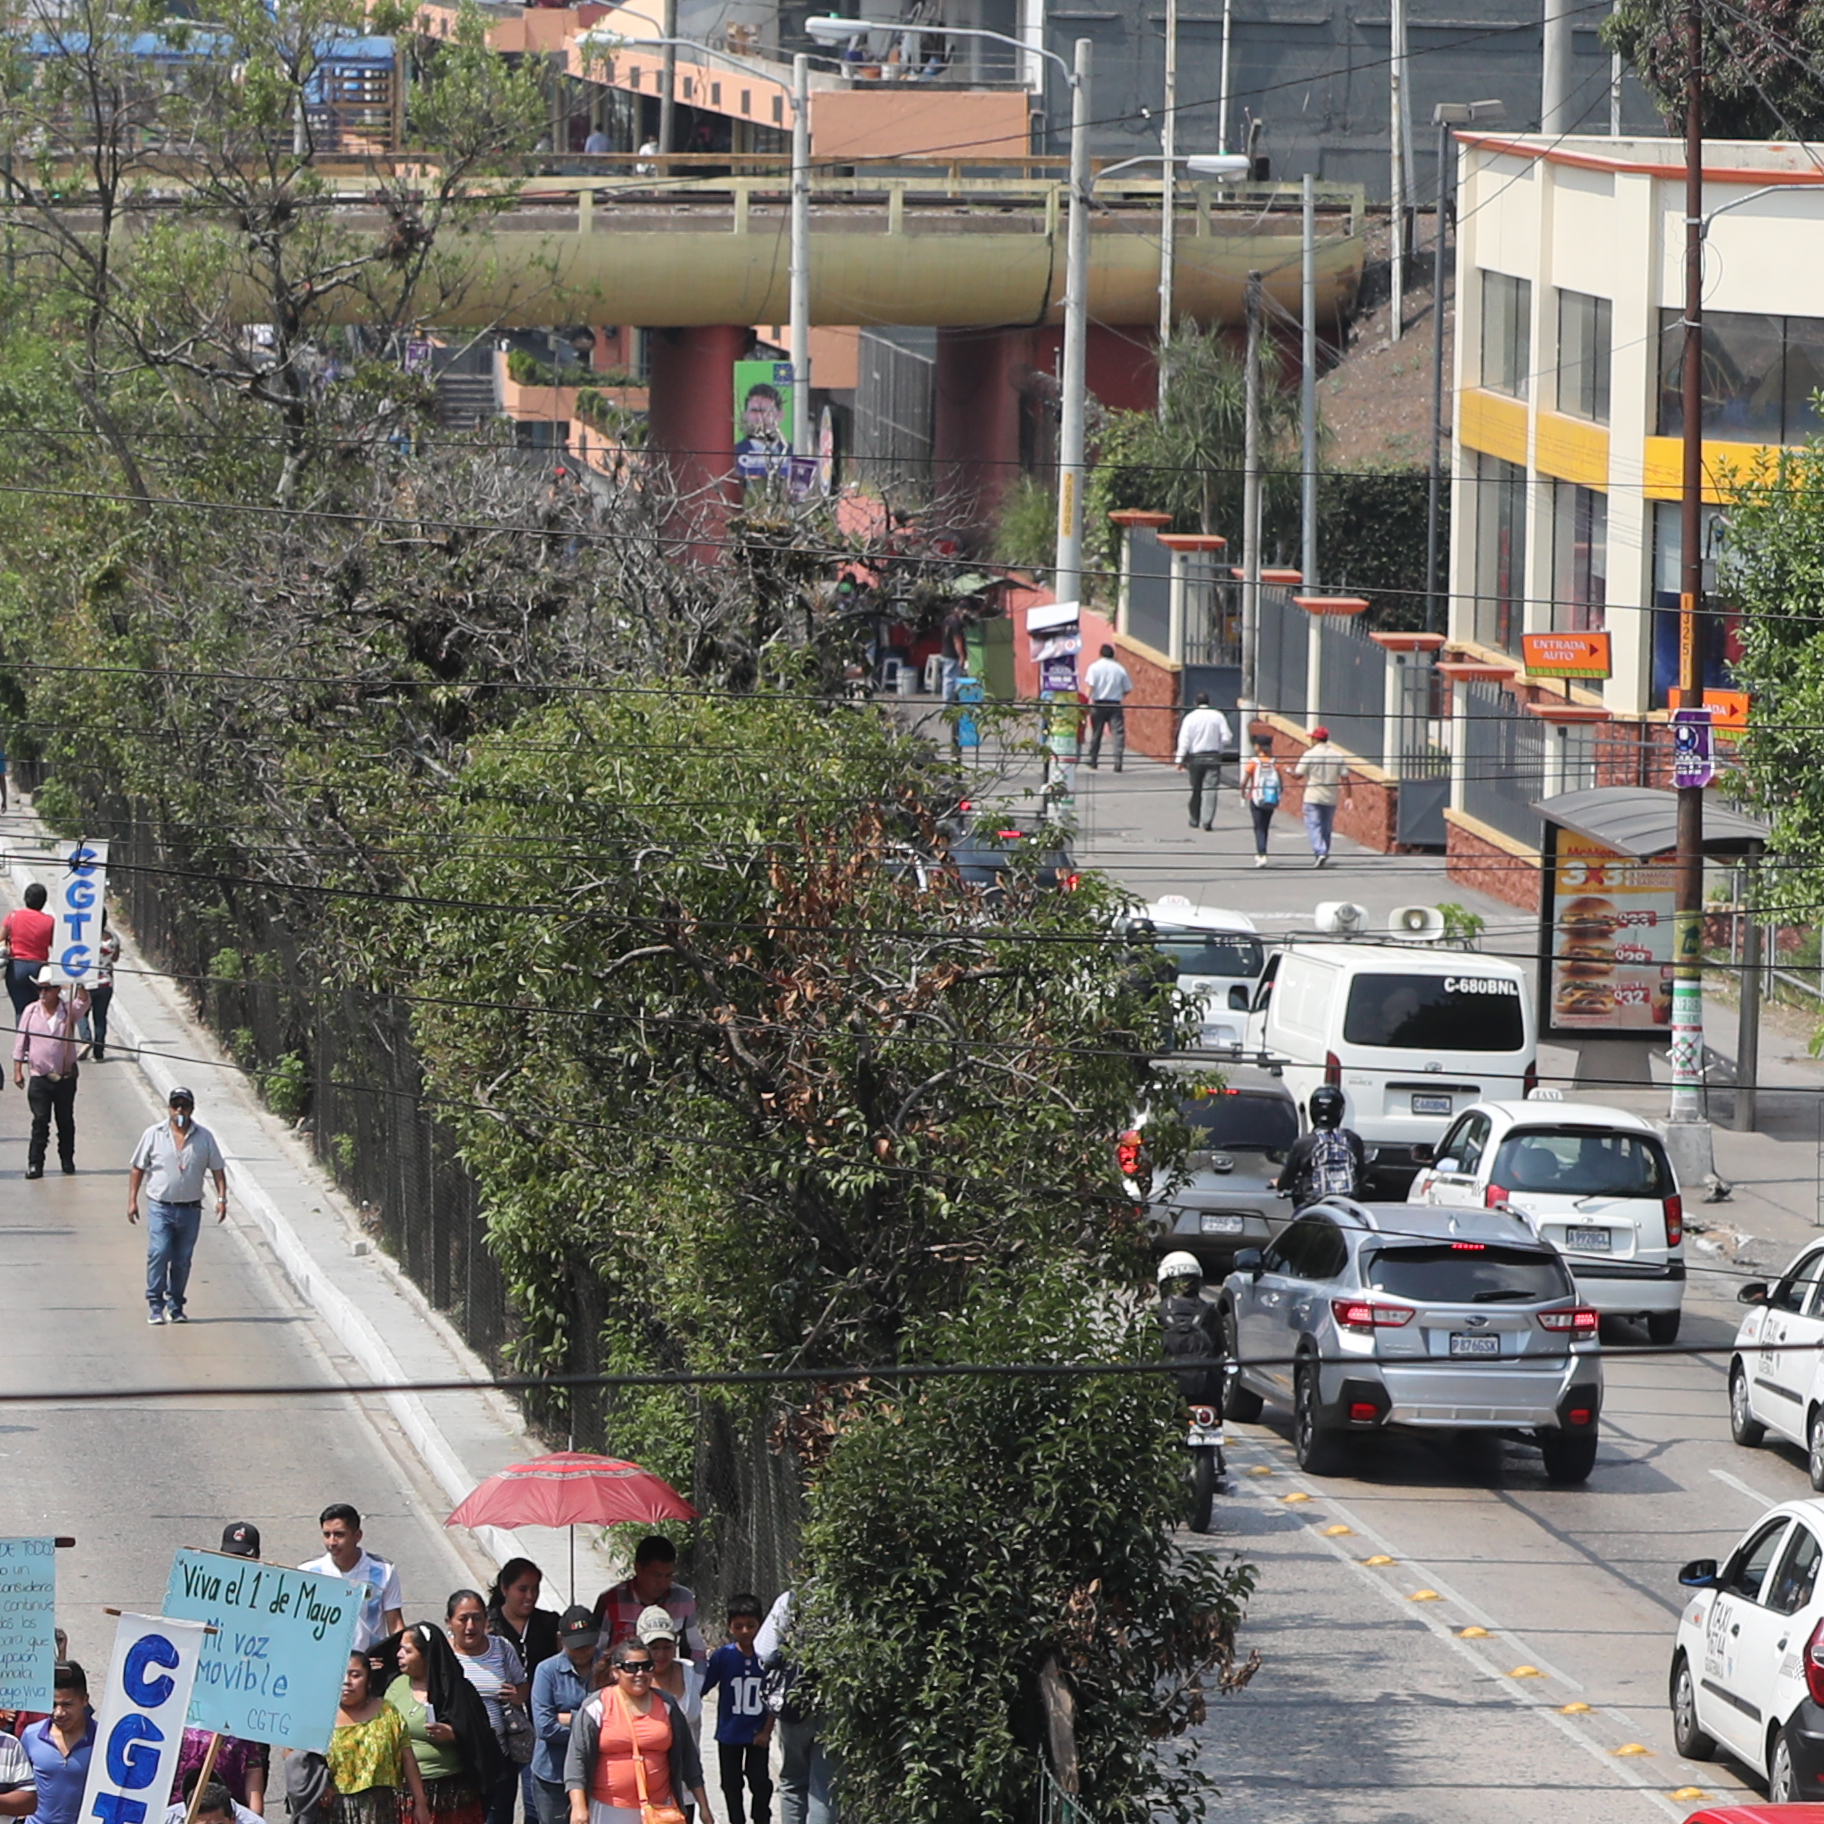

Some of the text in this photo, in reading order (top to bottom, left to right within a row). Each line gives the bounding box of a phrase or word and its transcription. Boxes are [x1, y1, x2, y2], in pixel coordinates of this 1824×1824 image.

[1533, 639, 1586, 652] ENTRADA
[1543, 650, 1574, 661] AUTO
[61, 847, 100, 977] CGTG
[1443, 978, 1519, 996] C-680BNL
[1535, 1091, 1560, 1100] TAXI
[225, 1567, 245, 1606] el
[269, 1573, 290, 1614] de
